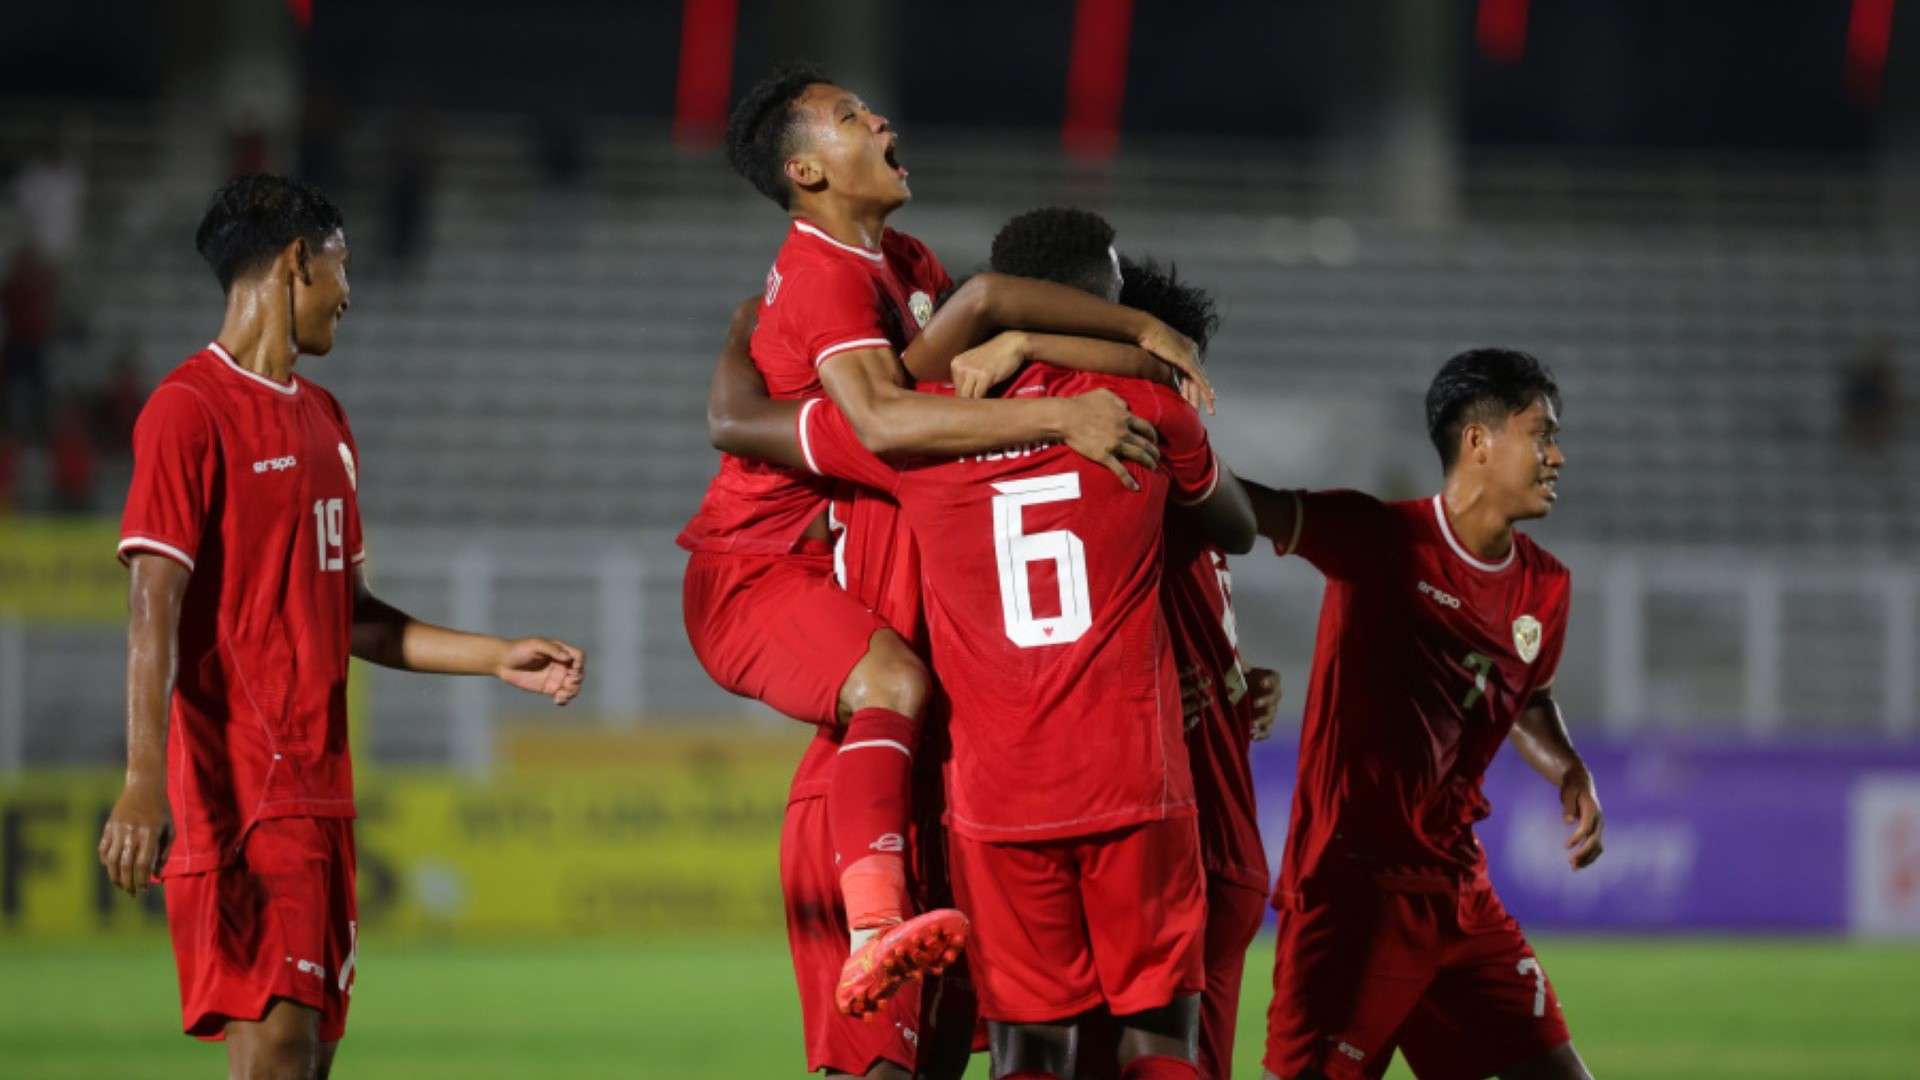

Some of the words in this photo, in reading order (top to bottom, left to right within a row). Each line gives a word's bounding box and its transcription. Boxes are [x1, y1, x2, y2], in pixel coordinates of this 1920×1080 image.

[253, 455, 297, 474] erspo
[313, 498, 344, 571] 19
[990, 471, 1092, 648] 6
[1417, 580, 1462, 609] erspo
[1462, 652, 1493, 709] 7
[1516, 957, 1546, 1017] 7
